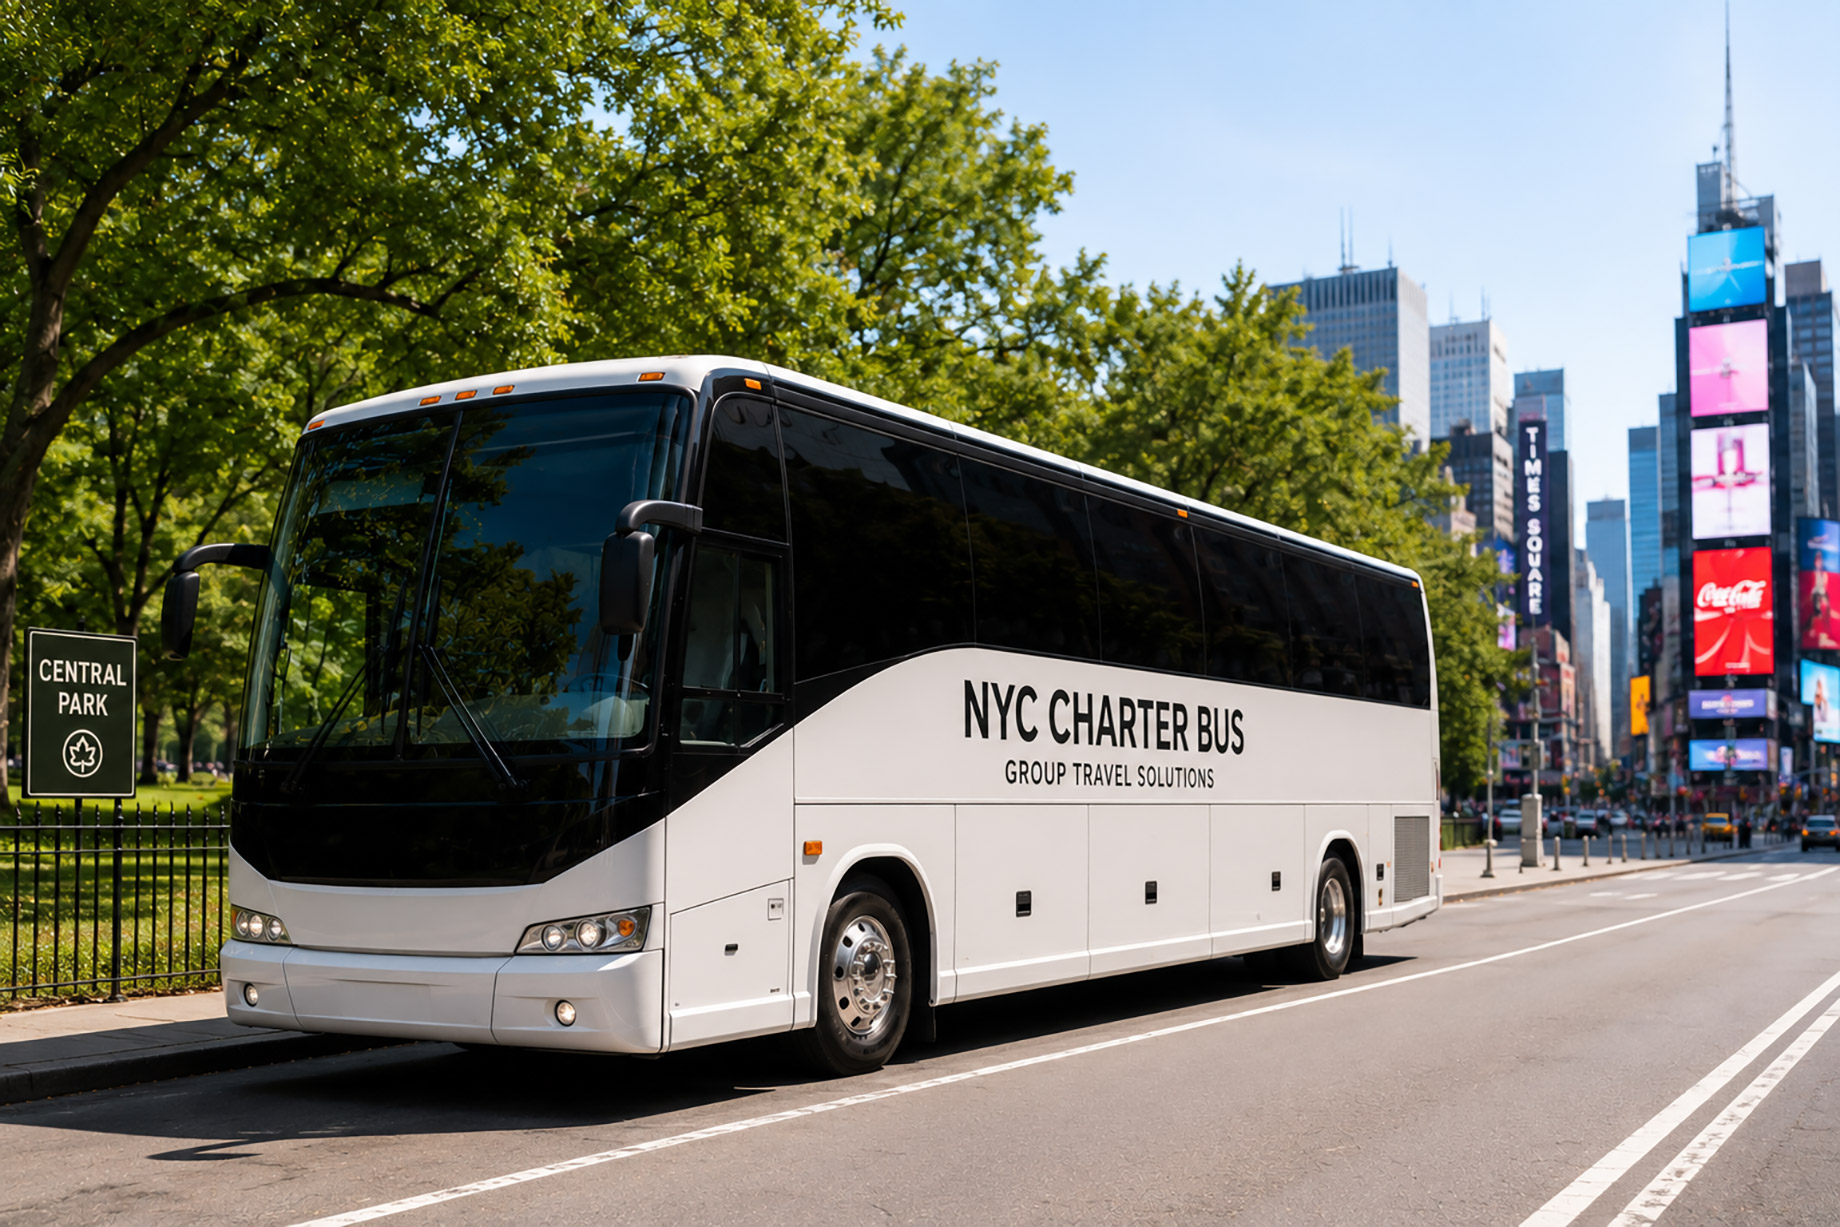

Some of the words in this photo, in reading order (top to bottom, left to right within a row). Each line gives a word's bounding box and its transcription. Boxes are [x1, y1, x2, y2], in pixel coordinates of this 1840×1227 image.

[1524, 426, 1542, 512] TIMES
[1526, 517, 1543, 615] SQUARE
[39, 658, 127, 687] CENTRAL
[58, 691, 109, 717] PARK
[964, 679, 1039, 743] NYC
[1049, 688, 1190, 752] CHARTER
[1197, 705, 1245, 756] BUS
[1005, 759, 1067, 786] GROUP
[1072, 762, 1132, 787] TRAVEL
[1137, 764, 1215, 789] SOLUTIONS
